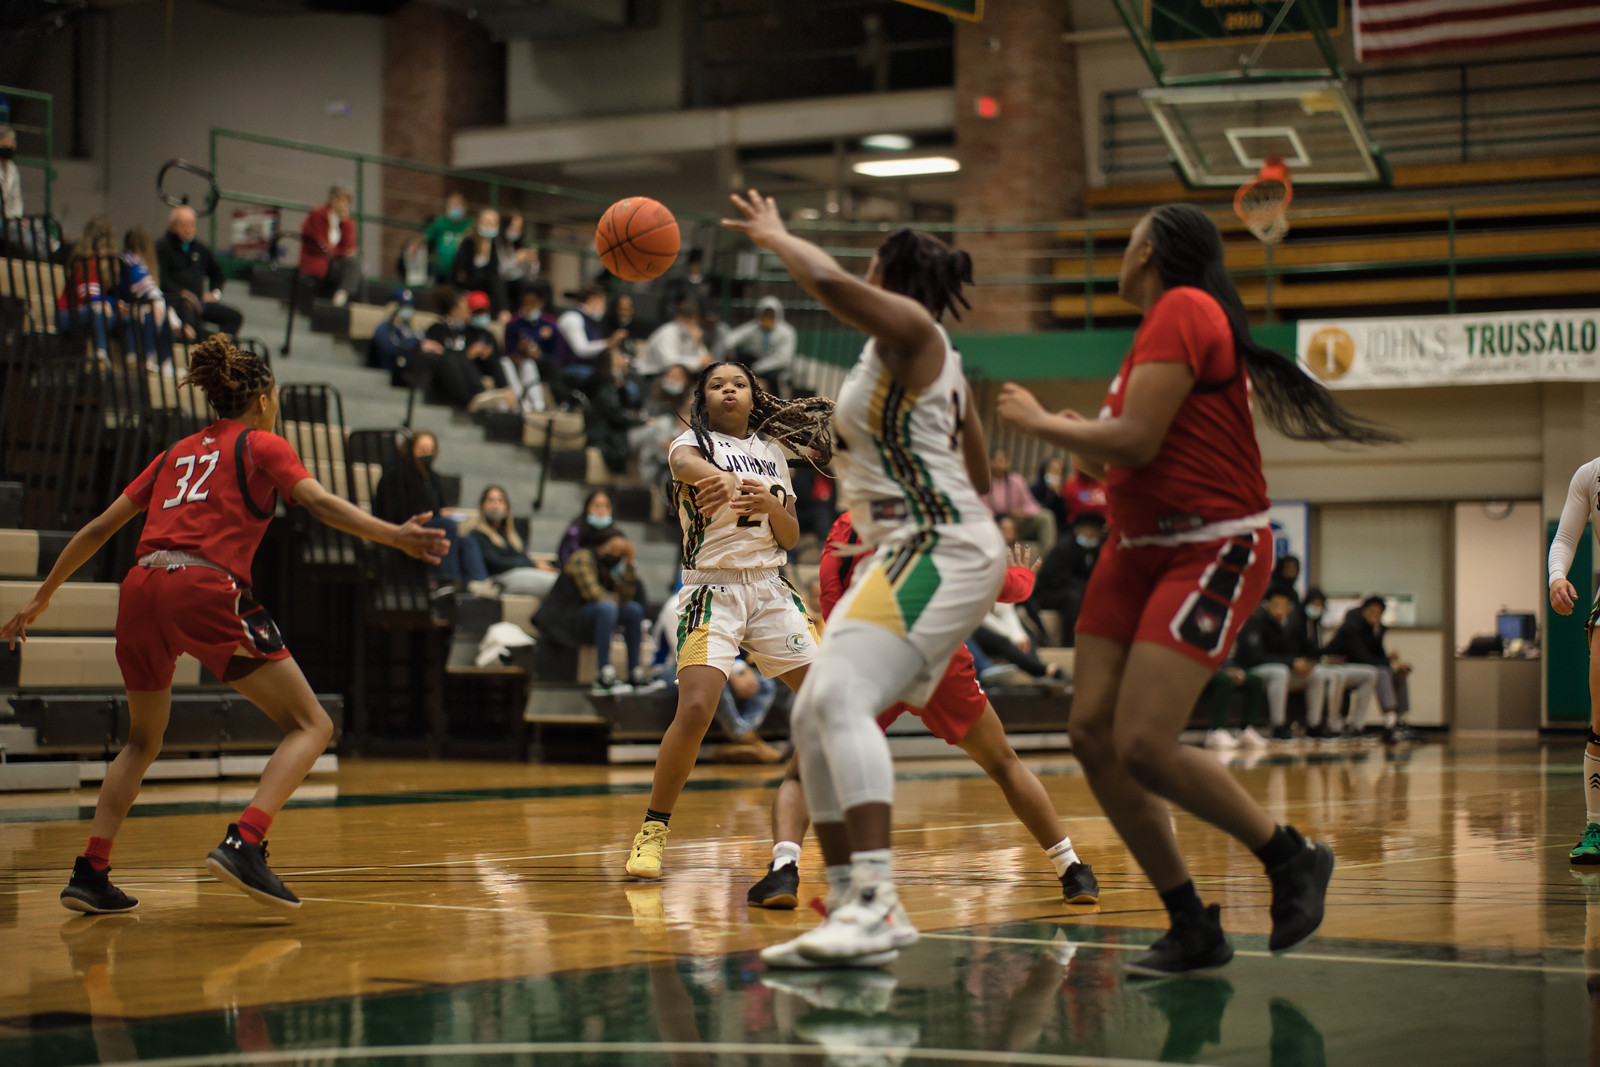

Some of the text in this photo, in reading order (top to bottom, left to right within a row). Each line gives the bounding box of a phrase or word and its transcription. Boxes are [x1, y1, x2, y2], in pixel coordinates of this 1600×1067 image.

[1365, 319, 1597, 363] JOHN S. TRUSSALO
[162, 450, 220, 509] 32
[725, 454, 782, 480] JAYHAWK
